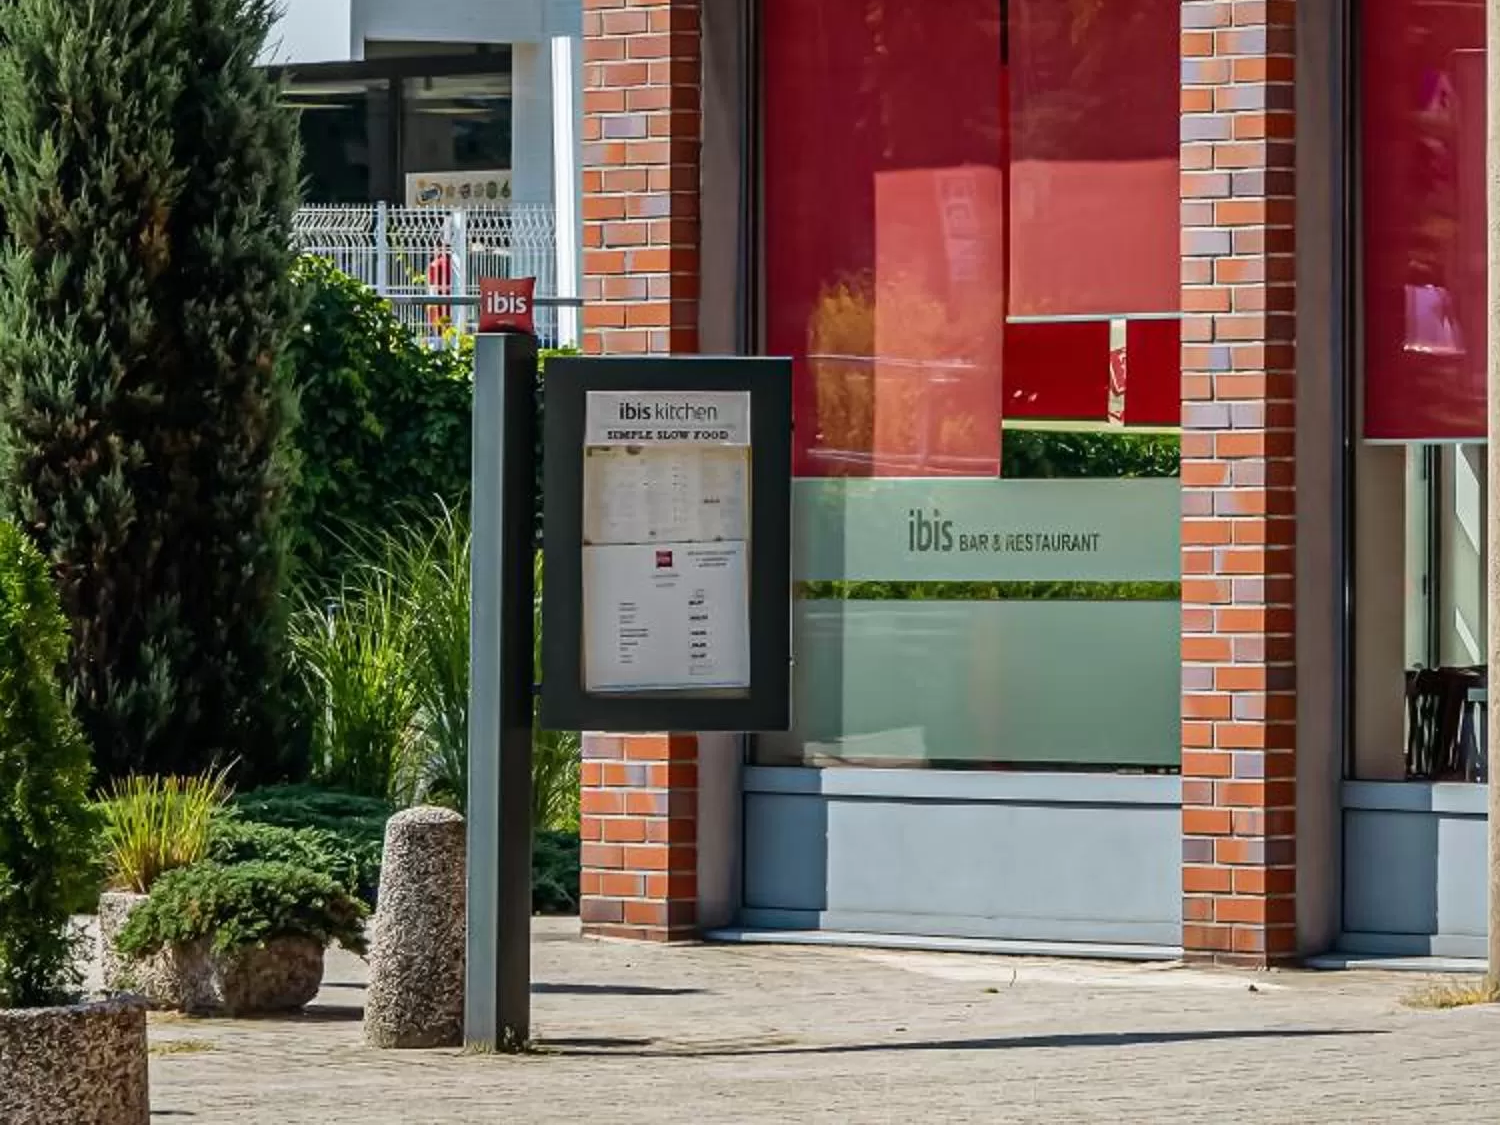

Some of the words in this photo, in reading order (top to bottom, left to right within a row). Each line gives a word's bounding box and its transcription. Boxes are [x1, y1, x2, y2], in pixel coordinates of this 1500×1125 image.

[487, 291, 528, 314] ibis
[619, 402, 651, 420] ibis
[655, 402, 718, 420] kitchen
[607, 430, 653, 440] SIMPLE
[656, 430, 690, 440] SLOW
[693, 430, 729, 440] FOOD
[908, 508, 953, 552] ibis
[959, 534, 989, 552] BAR
[993, 535, 1001, 552] &
[1005, 534, 1101, 552] RESTAURANT
